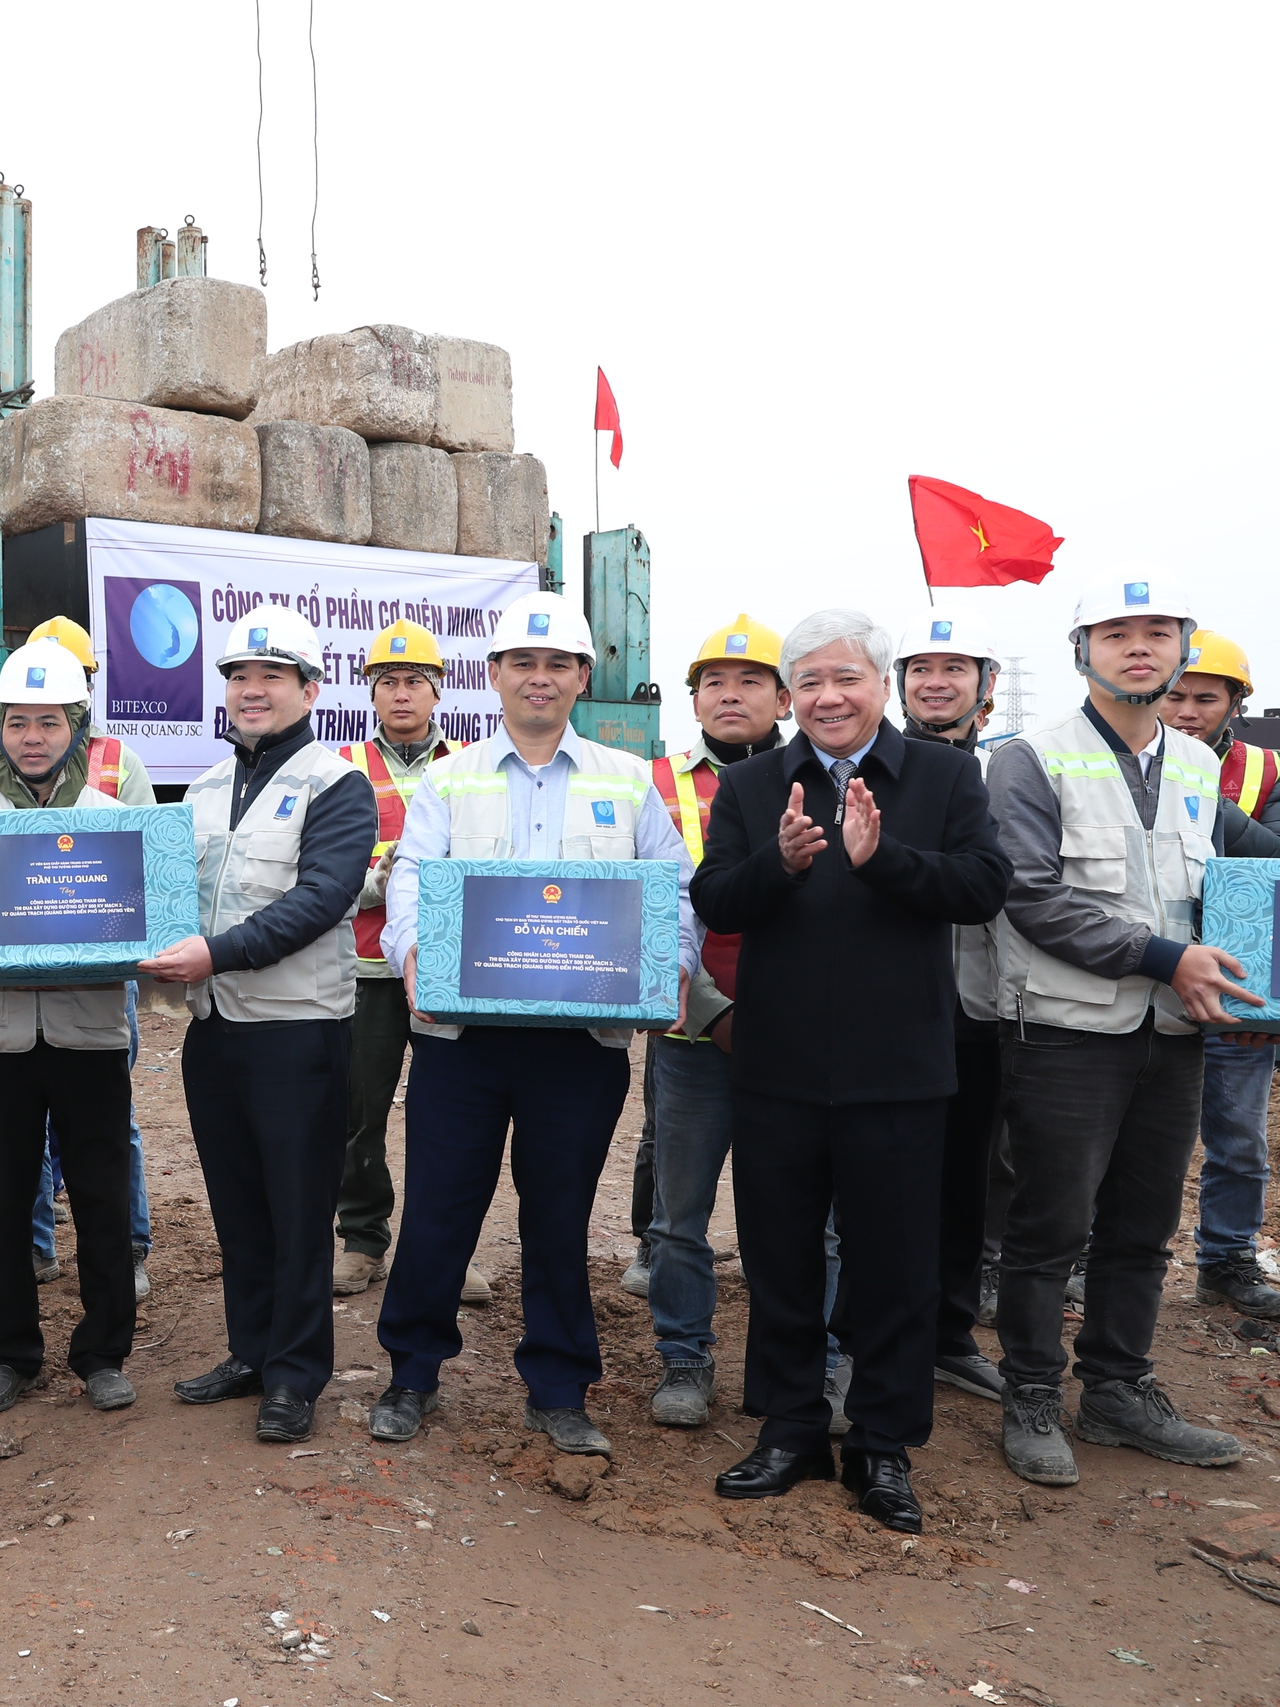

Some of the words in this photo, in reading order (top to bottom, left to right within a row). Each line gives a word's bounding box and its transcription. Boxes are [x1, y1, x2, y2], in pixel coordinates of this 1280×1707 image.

[326, 588, 374, 631] PHẦN
[378, 599, 400, 630] CƠ
[405, 598, 442, 635] ĐIỆN
[447, 606, 487, 638] MINH
[112, 700, 168, 714] BITEXCO
[316, 702, 368, 741] TRÌNH
[440, 706, 480, 742] ĐÚNG
[106, 723, 138, 736] MINH
[141, 724, 183, 738] QUANG
[185, 725, 203, 736] JSC
[26, 874, 51, 884] TRẦN
[75, 874, 107, 883] QUANG
[514, 923, 530, 934] ĐỖ
[532, 925, 554, 935] VĂN
[556, 925, 588, 936] CHIẾN
